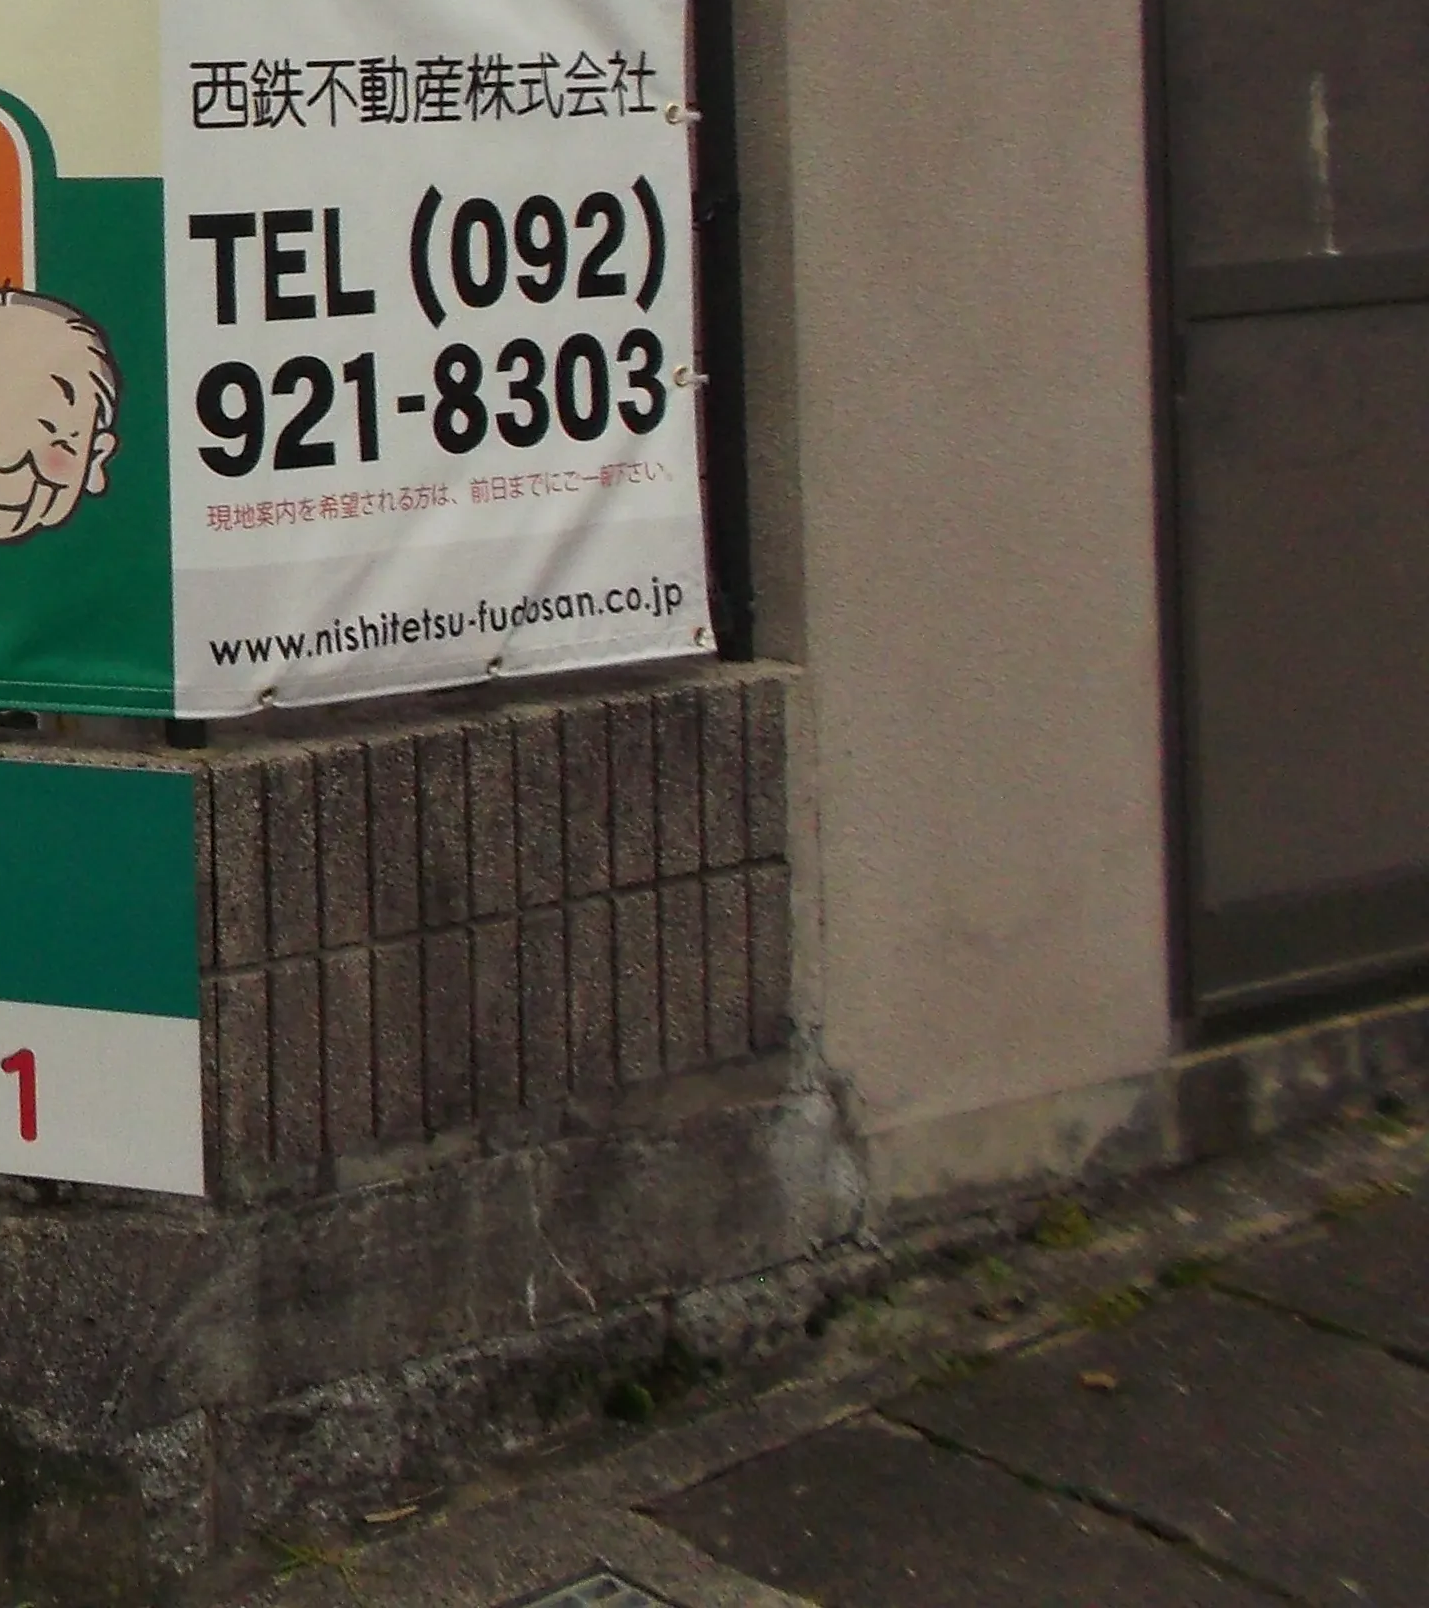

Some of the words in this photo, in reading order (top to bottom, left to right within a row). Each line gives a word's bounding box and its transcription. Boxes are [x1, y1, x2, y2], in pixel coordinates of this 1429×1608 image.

[189, 49, 659, 130] 西鉄不動産株式会社
[188, 206, 377, 326] TEL
[409, 174, 668, 328] (092)
[194, 327, 667, 479] 921-8303
[208, 574, 685, 667] www.nishitetsu-fudosan.co.jp
